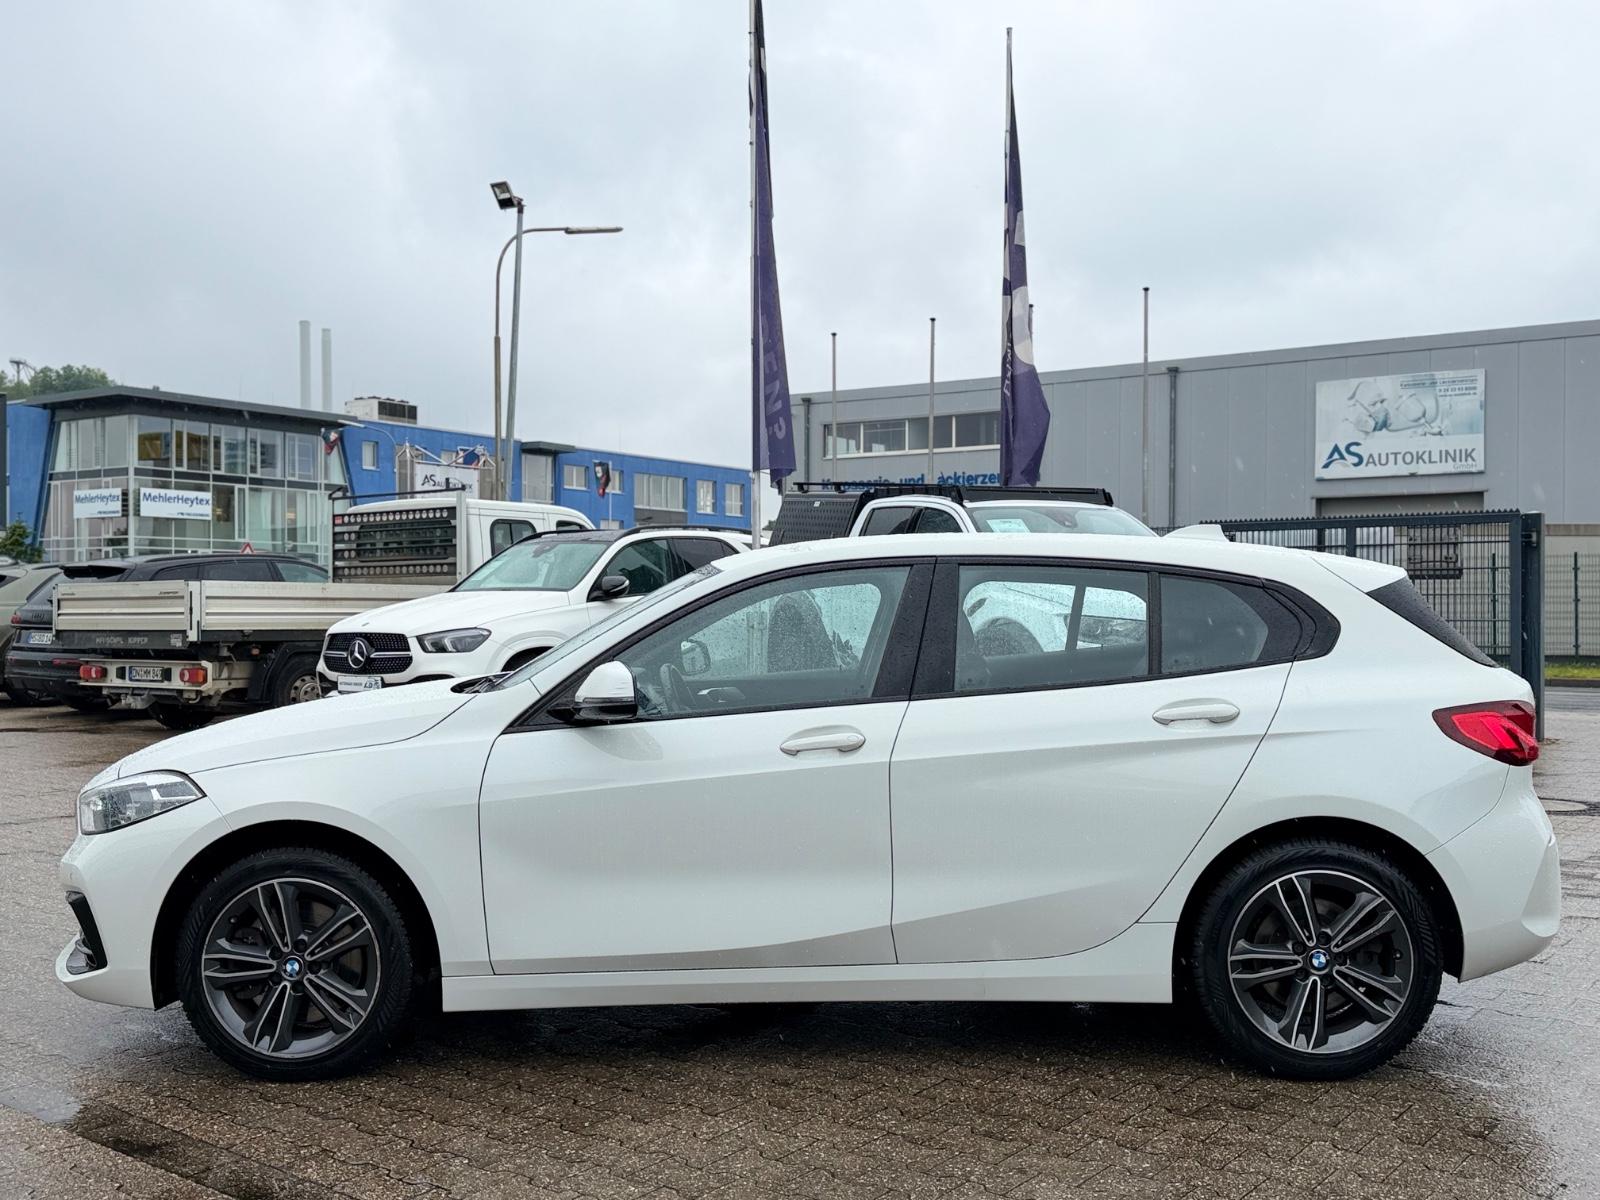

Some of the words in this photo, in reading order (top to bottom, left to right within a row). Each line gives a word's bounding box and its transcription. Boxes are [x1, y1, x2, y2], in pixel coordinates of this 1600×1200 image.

[1321, 441, 1364, 469] AS
[1365, 448, 1477, 467] AUTOKLINIK
[74, 493, 120, 506] MehlerHeytex
[142, 492, 210, 508] MehlerHeytex
